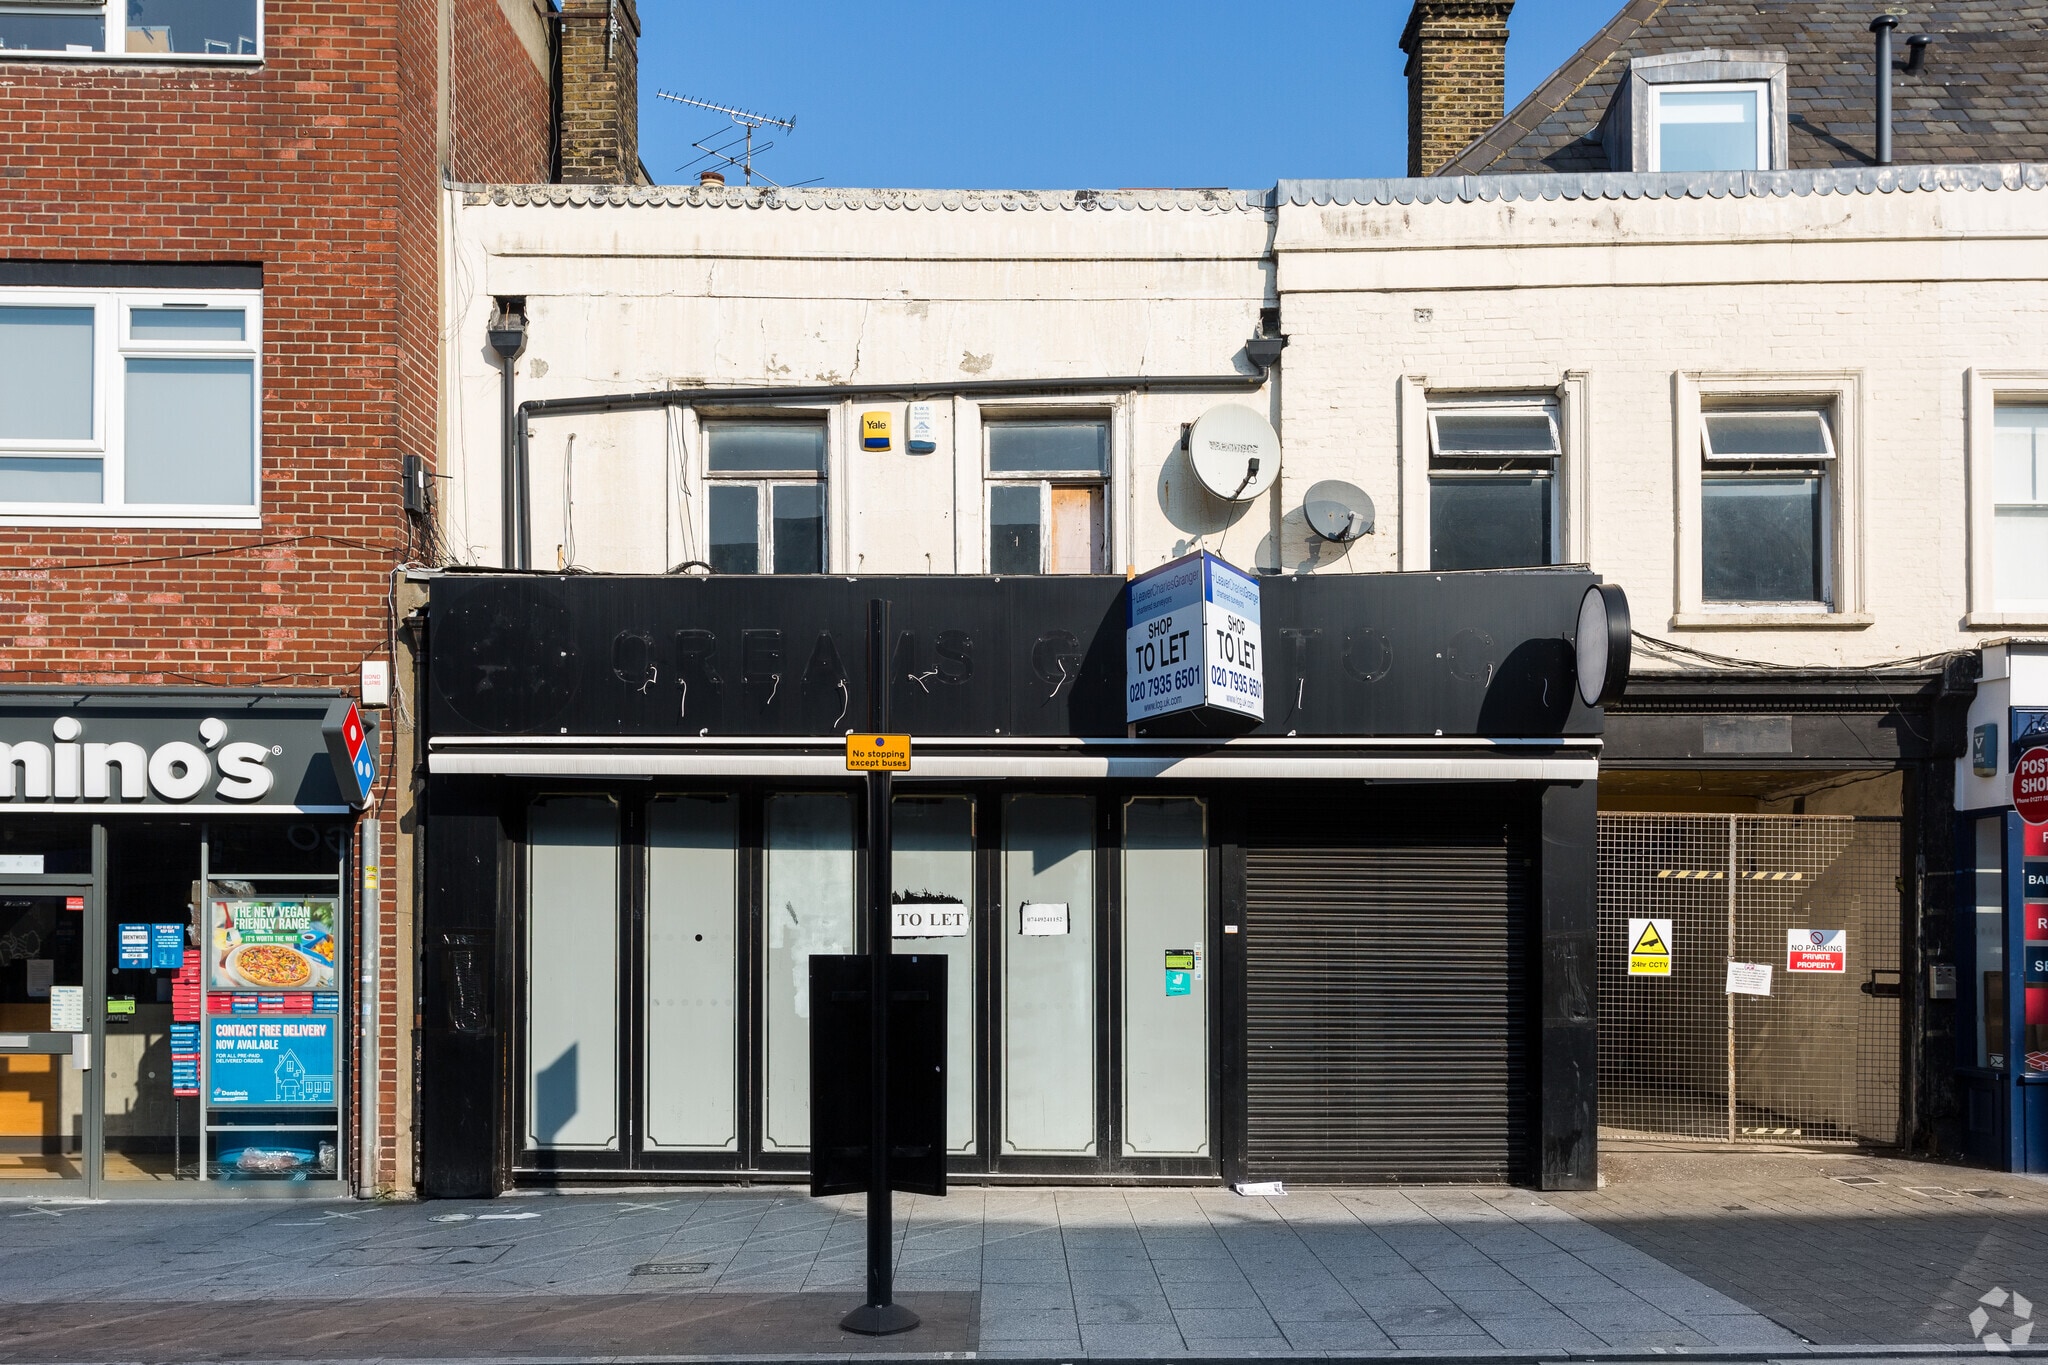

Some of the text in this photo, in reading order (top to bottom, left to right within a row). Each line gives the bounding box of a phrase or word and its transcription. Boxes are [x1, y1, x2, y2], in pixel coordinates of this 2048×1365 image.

[866, 420, 887, 429] Yale
[1148, 616, 1173, 639] SHOP
[1227, 614, 1246, 636] SHOP
[1135, 630, 1190, 674] TO LET
[1216, 629, 1256, 672] TO LET
[1129, 665, 1200, 703] 020 7935 6501
[1211, 664, 1263, 700] 020 7935 6501
[852, 750, 905, 759] No stopping
[850, 759, 907, 768] except buses
[2021, 776, 2048, 793] SHO
[233, 906, 311, 918] THE NEW VEGAN
[233, 918, 311, 930] FRIENDLY RANGE
[897, 913, 964, 926] TO LET
[1796, 961, 1836, 969] PROPERTY
[215, 1024, 327, 1037] CONTACT FREE DELIVERY
[215, 1039, 279, 1050] NOW AVAILABLE
